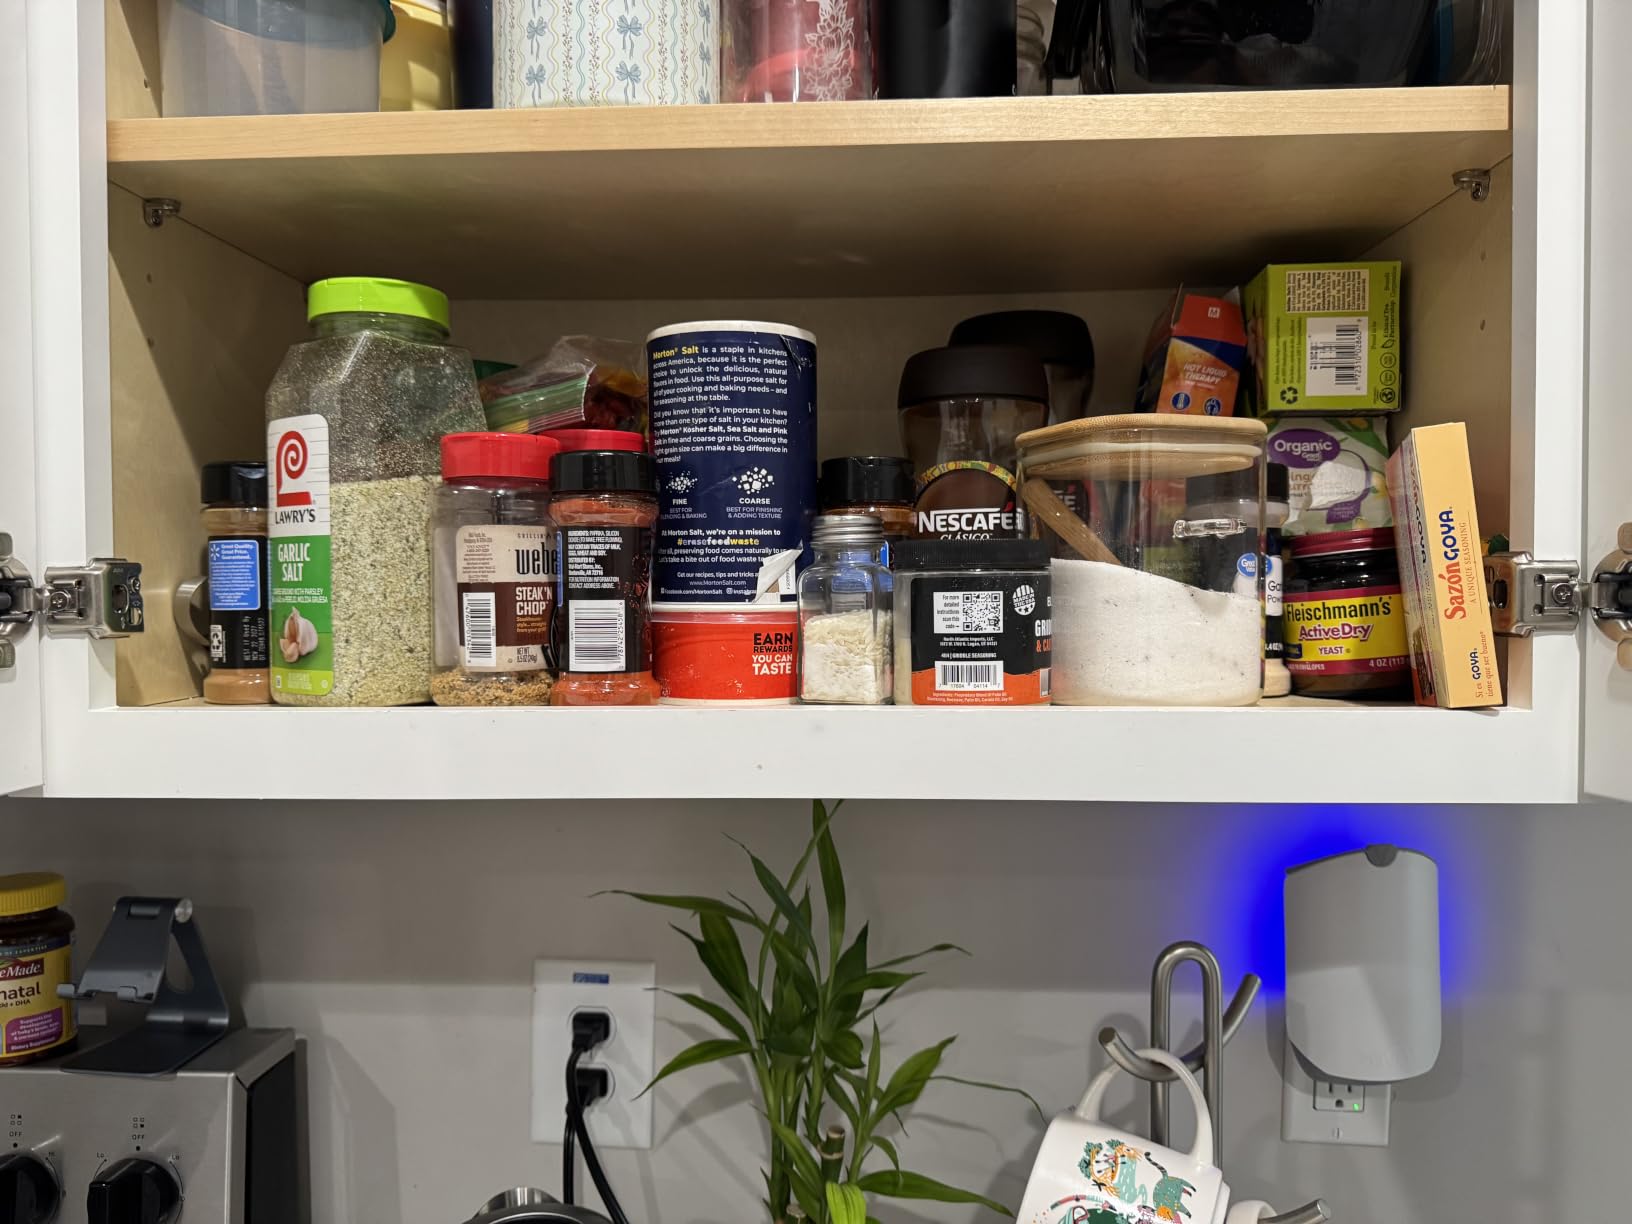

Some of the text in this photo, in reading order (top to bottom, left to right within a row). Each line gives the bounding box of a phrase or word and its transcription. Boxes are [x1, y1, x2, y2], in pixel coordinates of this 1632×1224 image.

[682, 346, 699, 355] Salt
[720, 346, 744, 355] staple
[759, 346, 788, 357] kitchens
[668, 357, 696, 366] America,
[748, 356, 761, 364] the
[764, 358, 788, 366] perfect
[679, 366, 703, 374] unlock
[724, 365, 760, 374] delicious,
[764, 367, 788, 376] natural
[1184, 363, 1228, 377] HOT LIQUID
[722, 375, 764, 384] all-purpose
[765, 376, 778, 384] salt
[1185, 372, 1221, 385] THERAPY
[676, 384, 770, 393] cooking and baking needs
[660, 396, 687, 406] seasoning
[692, 406, 706, 414] that
[722, 406, 761, 415] important
[772, 408, 788, 416] have
[742, 417, 759, 425] your
[760, 416, 788, 426] kitchen?
[708, 426, 726, 434] Salt,
[774, 427, 788, 435] Pink
[718, 434, 743, 443] grains.
[744, 436, 777, 445] Choosing
[705, 444, 781, 453] make big difference
[1274, 438, 1333, 456] Organic
[275, 508, 316, 525] LAWRY'S
[689, 528, 705, 537] Salt,
[706, 528, 726, 536] we're
[746, 528, 772, 536] mission
[677, 536, 760, 546] #erasefoodwaste
[1460, 522, 1472, 565] SEASONING
[278, 543, 311, 562] GARLIC
[674, 547, 705, 555] preserving
[745, 547, 773, 555] naturally
[1438, 510, 1466, 620] Sazón GOYA
[282, 562, 304, 582] SALT
[1465, 566, 1476, 597] UNIQUE
[516, 586, 553, 601] STEAK 'N
[516, 602, 546, 616] CHOP
[1287, 597, 1392, 622] Fleischmann's
[754, 632, 793, 646] EARN
[753, 644, 793, 654] REWARDS
[1036, 640, 1042, 653] &
[1318, 646, 1344, 655] YEAST
[752, 654, 793, 664] YOU CAN
[1369, 658, 1387, 668] 4 OZ
[1482, 656, 1490, 666] ser
[752, 662, 792, 676] TASTE
[1470, 651, 1484, 698] Si GOYA
[1482, 666, 1493, 680] que
[1483, 680, 1494, 697] tiene
[0, 982, 41, 1001] natal
